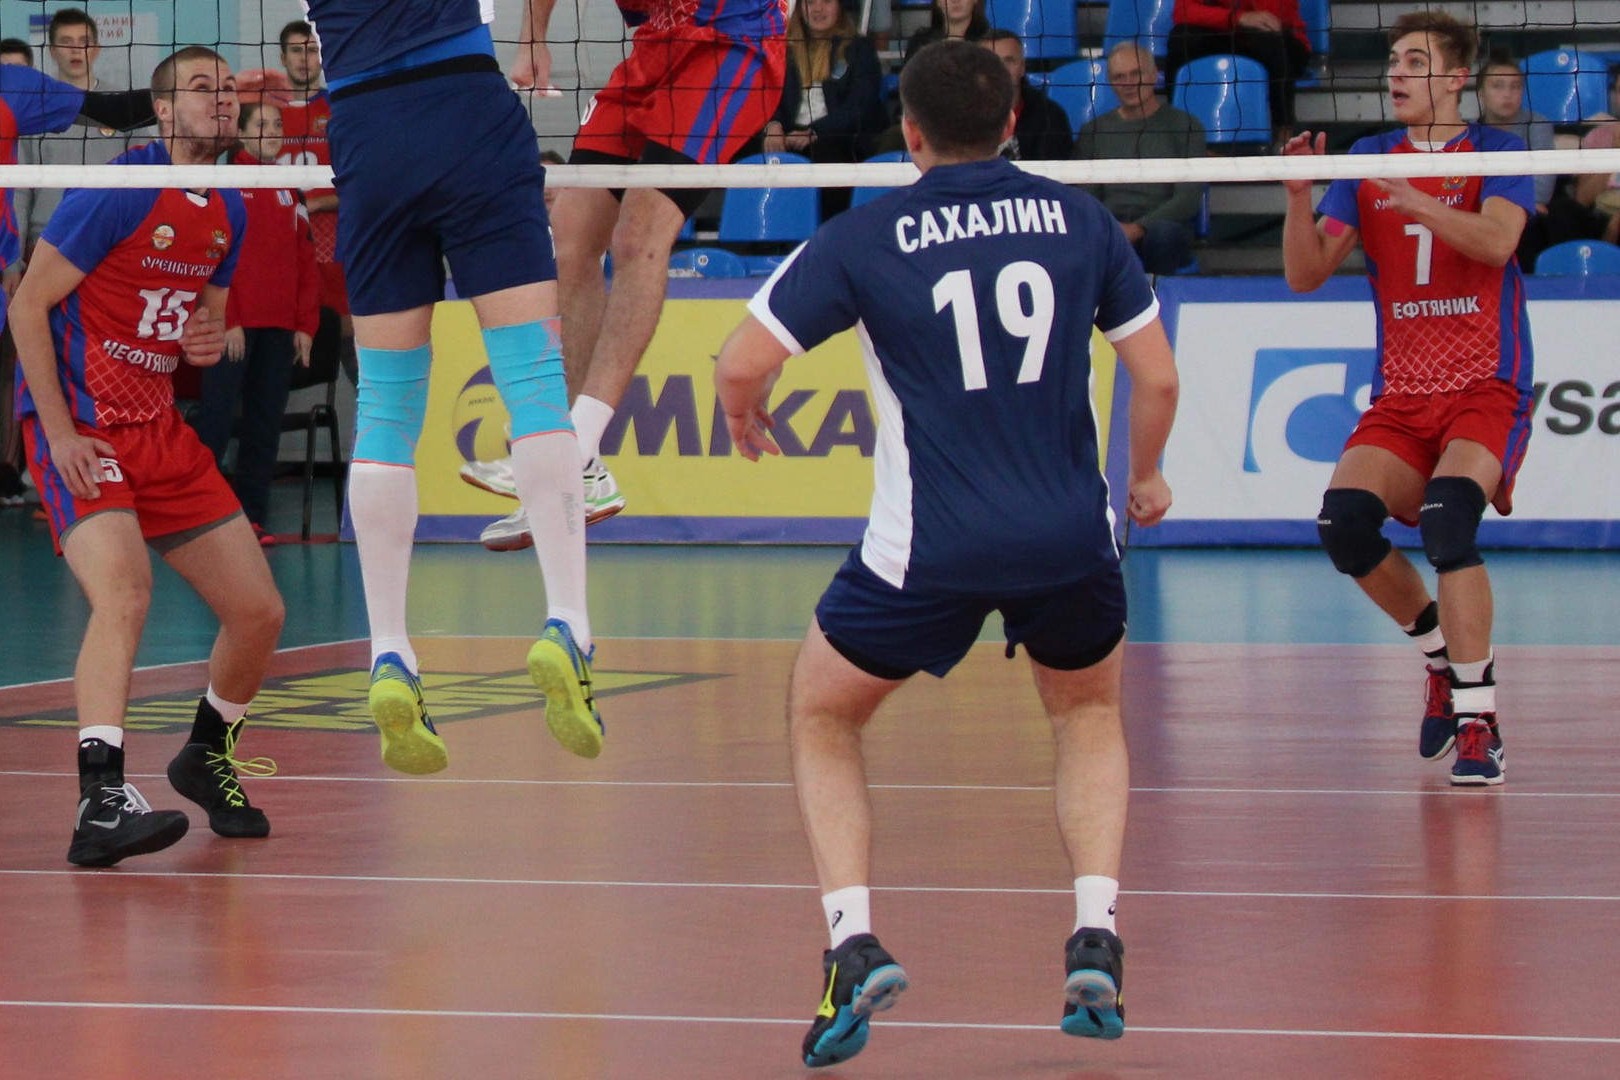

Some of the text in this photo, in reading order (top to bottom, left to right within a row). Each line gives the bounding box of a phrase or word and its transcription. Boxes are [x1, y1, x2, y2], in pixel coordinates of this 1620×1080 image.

[895, 197, 1067, 254] САХАЛИН
[136, 287, 197, 341] 15
[932, 260, 1055, 391] 19
[1392, 296, 1481, 320] ЕФТЯНИК
[102, 339, 179, 373] НЕФТЯНИ
